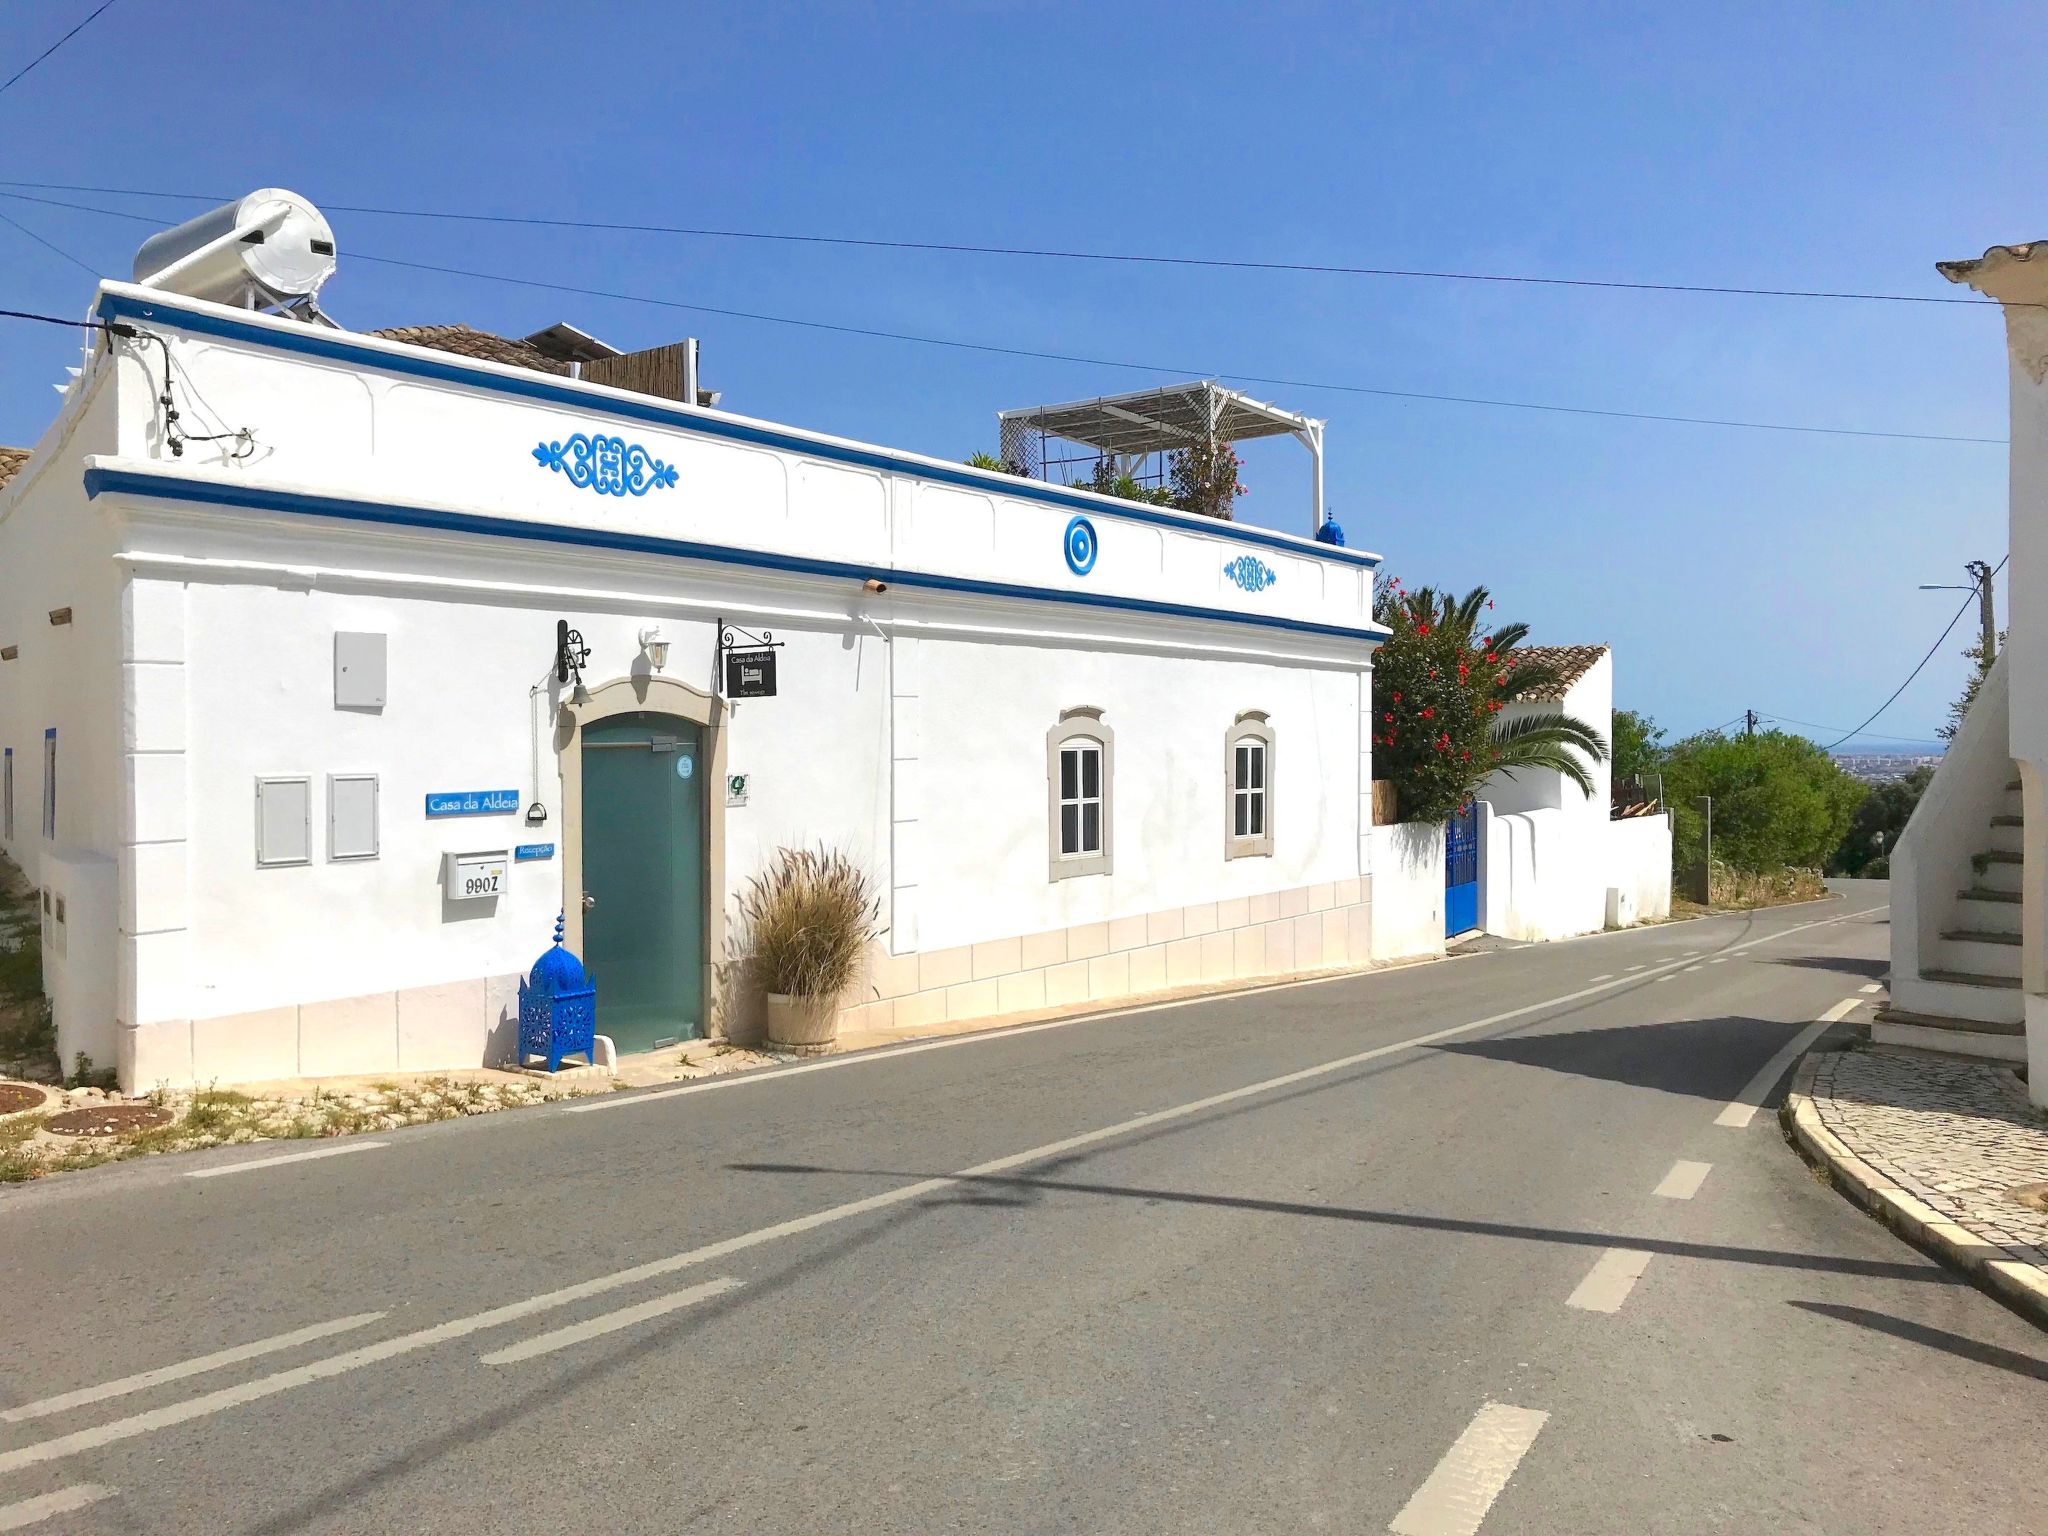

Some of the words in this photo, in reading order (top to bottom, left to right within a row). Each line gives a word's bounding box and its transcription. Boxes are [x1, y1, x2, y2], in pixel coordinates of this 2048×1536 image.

[731, 656, 746, 664] Casa
[746, 653, 754, 663] da
[430, 798, 461, 811] Casa
[463, 793, 479, 809] da
[481, 792, 519, 809] Aldeia
